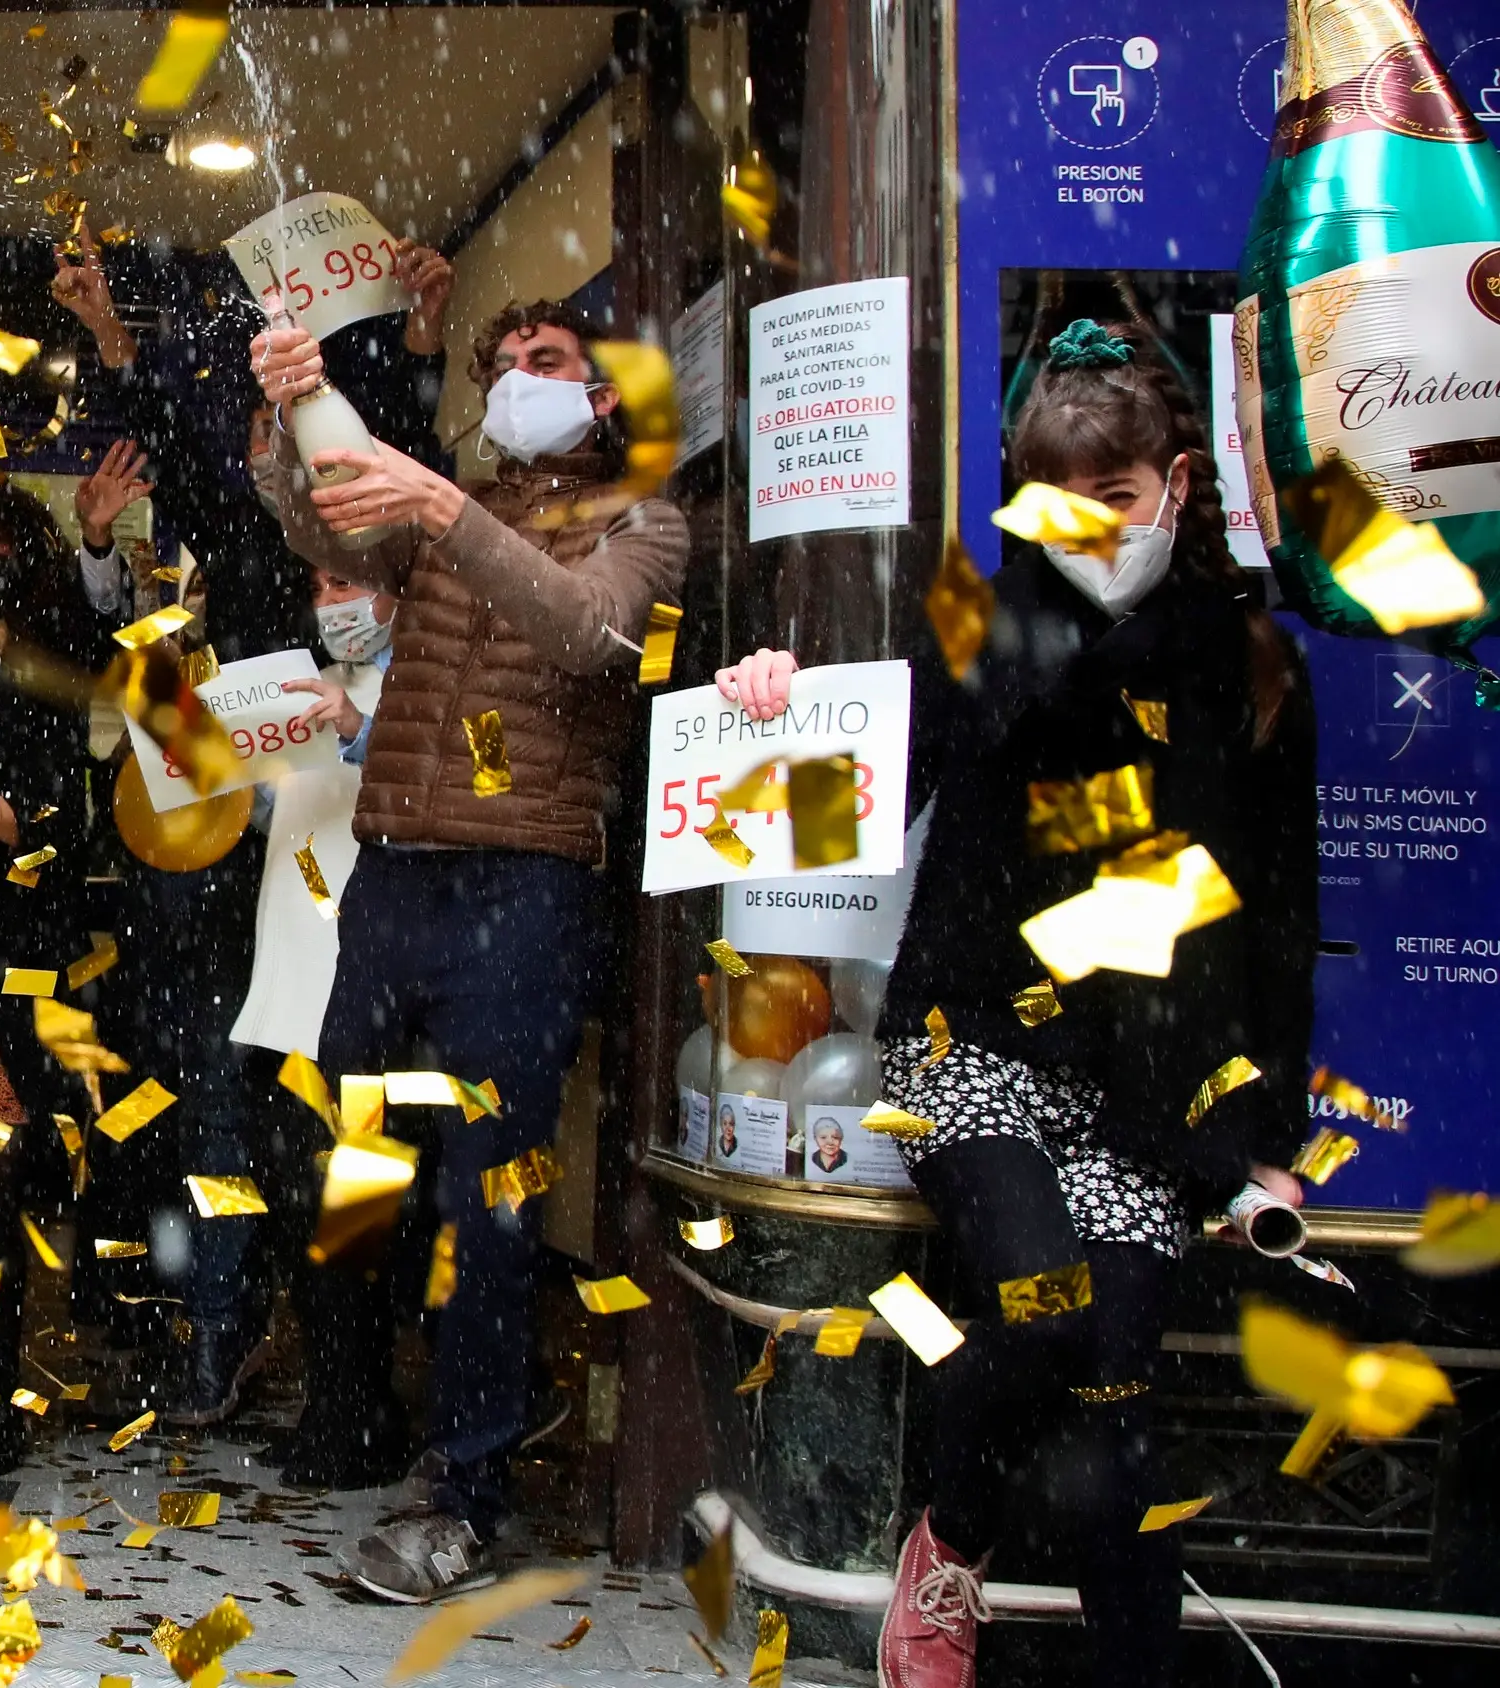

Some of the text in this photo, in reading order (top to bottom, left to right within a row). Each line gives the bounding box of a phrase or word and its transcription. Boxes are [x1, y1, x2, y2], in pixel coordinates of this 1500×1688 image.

[1136, 46, 1144, 61] 1
[1058, 165, 1143, 181] PRESIONE
[1058, 184, 1145, 203] EL BOTÓN
[762, 299, 886, 334] EN CUMPLIMIENTO
[771, 319, 872, 349] DE LAS MEDIDAS
[783, 340, 855, 363] SANITARIAS
[759, 353, 892, 388] PARA LA CONTENCIÓN
[776, 376, 866, 401] DEL COVID-19
[1335, 359, 1500, 431] Châtea
[756, 395, 896, 432] ES OBLIGATORIO
[774, 423, 870, 451] QUE LA FILA
[778, 448, 865, 474] SE REALICE
[756, 471, 897, 505] DE UNO EN UNO
[673, 715, 706, 752] 5º
[1331, 786, 1357, 802] SU
[1361, 787, 1397, 804] TLF.
[1401, 785, 1461, 806] MÓVIL
[1464, 790, 1478, 806] Y
[1333, 813, 1358, 830] UN
[1363, 814, 1403, 832] SMS
[1407, 815, 1487, 834] CUANDO
[1365, 843, 1390, 859] SU
[1394, 843, 1459, 861] TURNO
[745, 890, 879, 912] DE SEGURIDAD
[1396, 936, 1457, 954] RETIRE
[1403, 965, 1498, 984] SU TURNO
